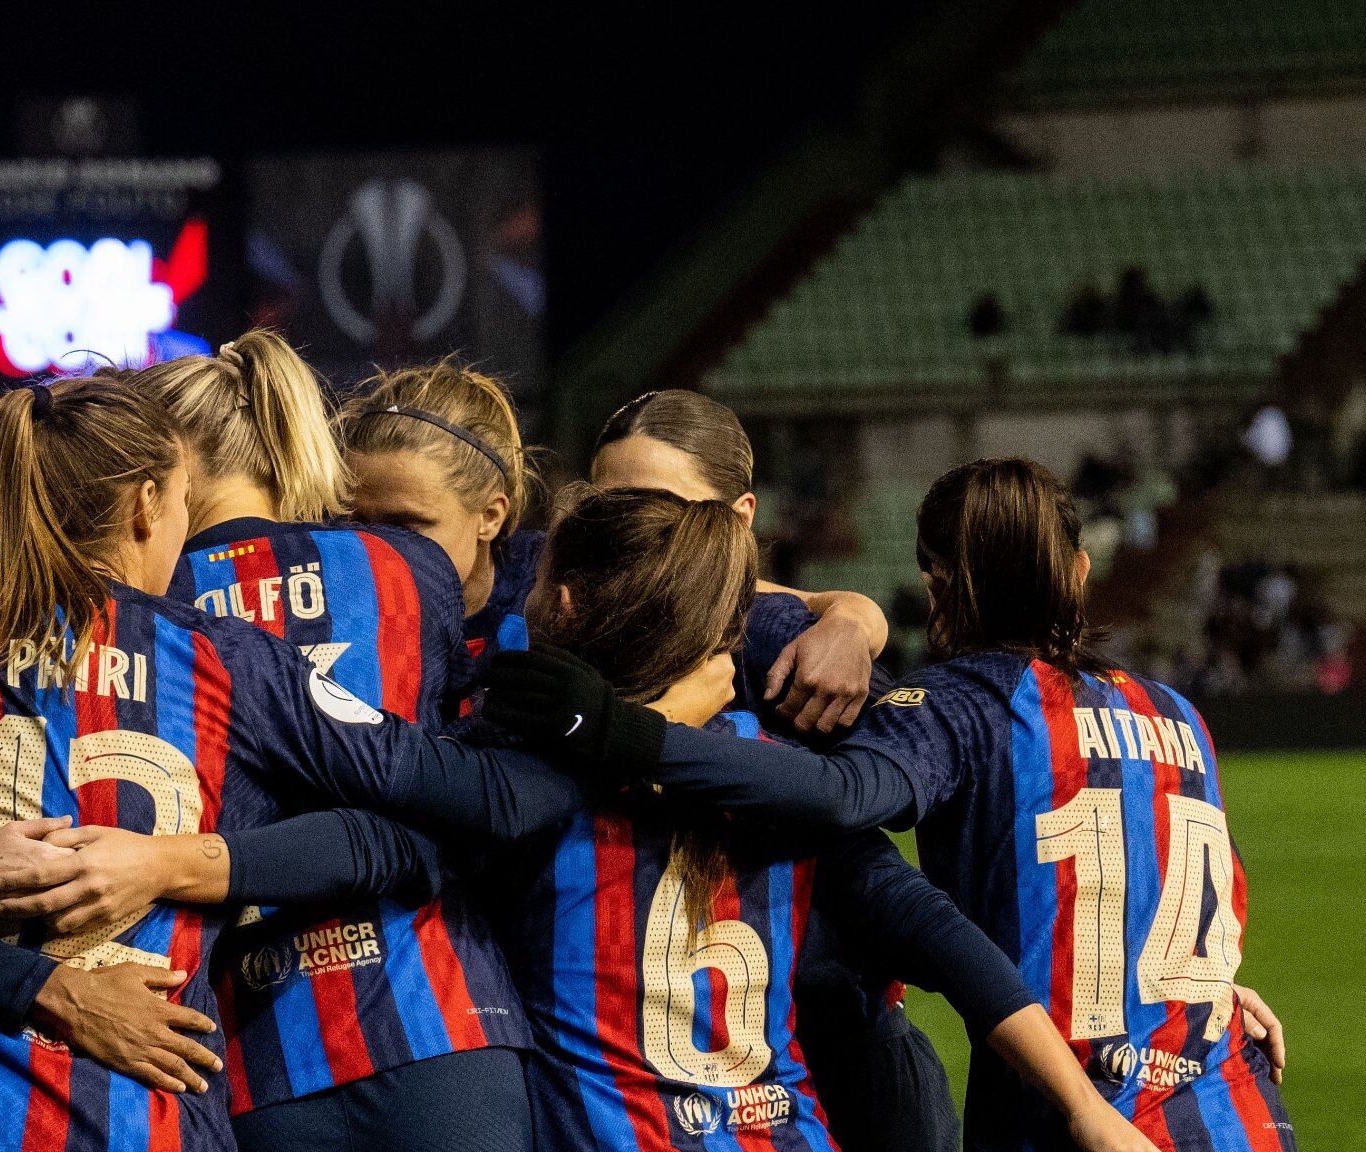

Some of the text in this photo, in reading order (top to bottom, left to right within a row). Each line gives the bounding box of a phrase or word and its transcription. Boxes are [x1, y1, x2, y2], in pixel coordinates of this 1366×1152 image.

[193, 561, 325, 622] OLFÖ
[7, 637, 147, 703] PATRI
[1073, 708, 1206, 774] AITANA
[294, 922, 377, 951] UNHCR
[1035, 788, 1241, 1042] 14
[298, 939, 381, 971] ACNUR
[642, 856, 771, 1087] 6
[1140, 1047, 1202, 1075] UNHCR
[727, 1084, 789, 1109] UNHCR
[727, 1100, 790, 1125] ACNUR
